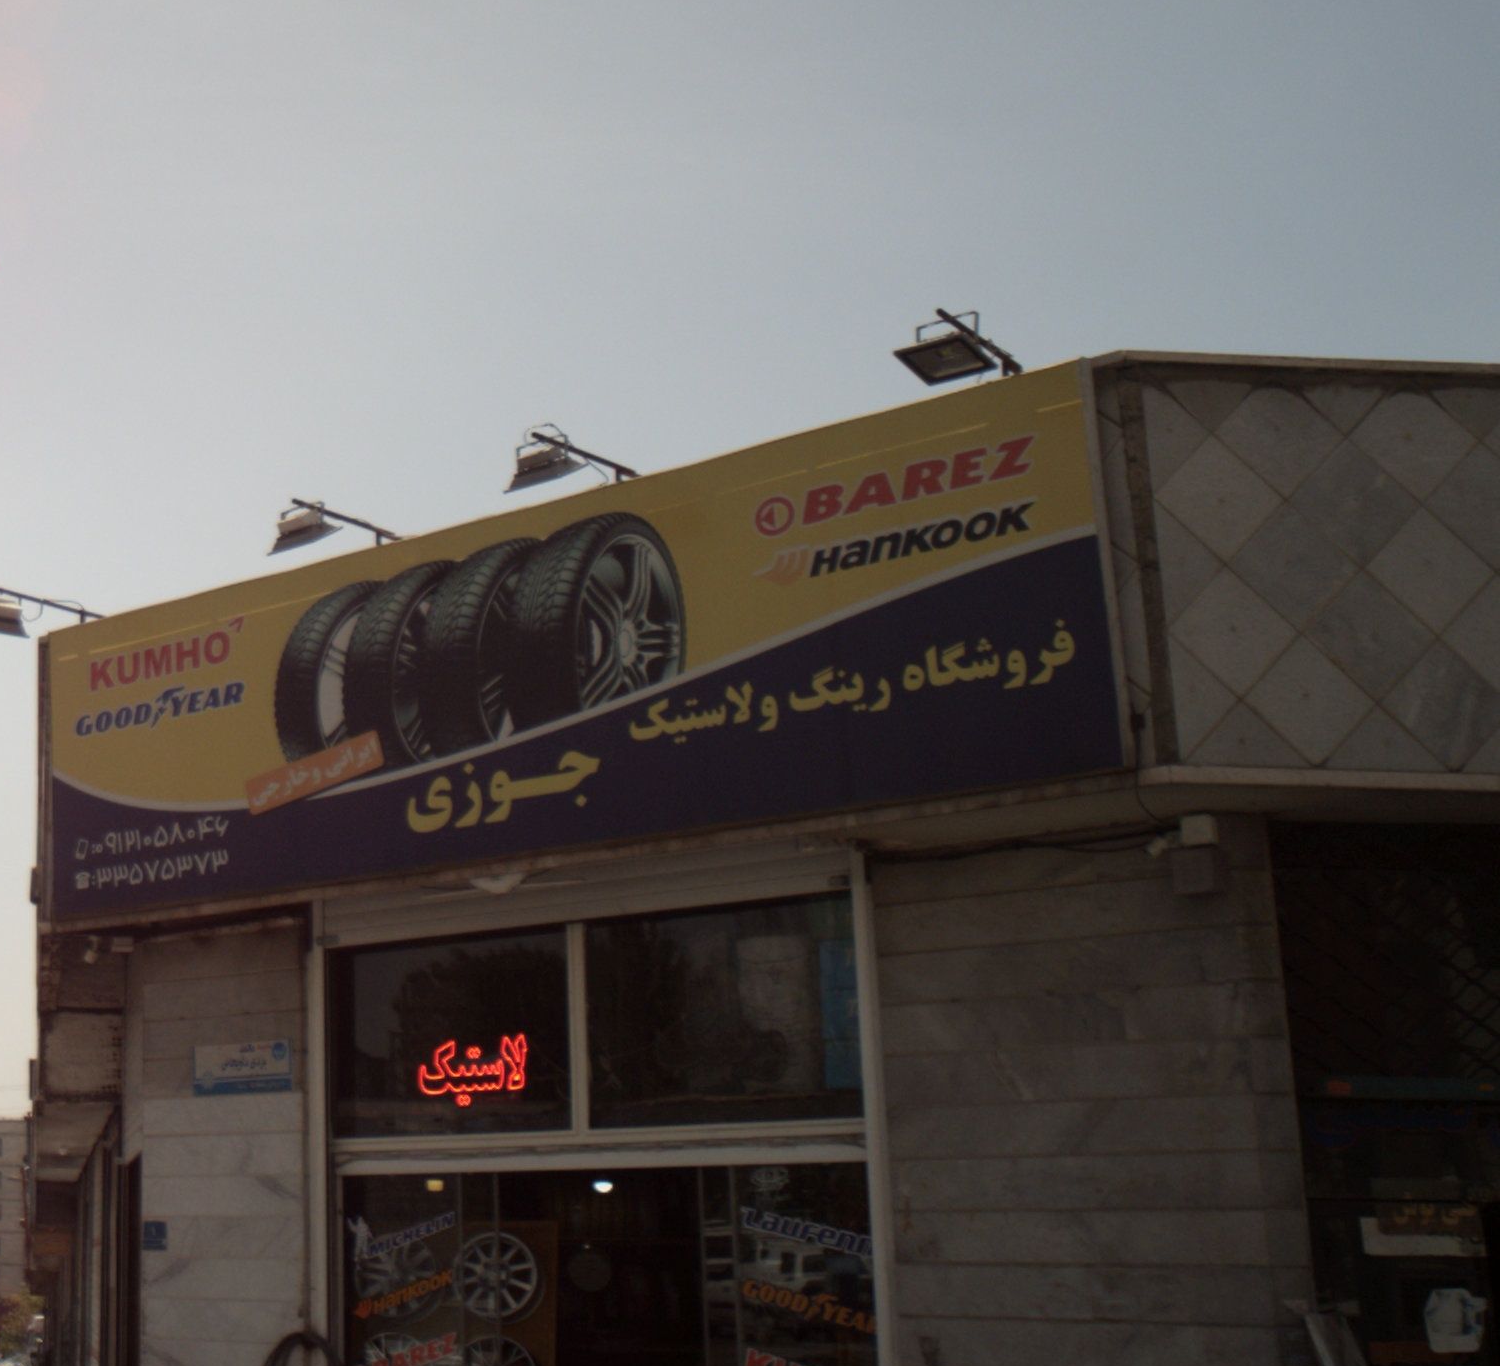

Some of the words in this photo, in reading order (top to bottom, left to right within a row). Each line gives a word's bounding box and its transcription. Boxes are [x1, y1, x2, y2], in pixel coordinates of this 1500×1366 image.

[801, 436, 1034, 525] BAREZ
[89, 630, 230, 691] KUMHO
[789, 666, 892, 714] رینگ
[902, 619, 1077, 691] فروشگاه
[418, 1032, 528, 1108] لاستیک
